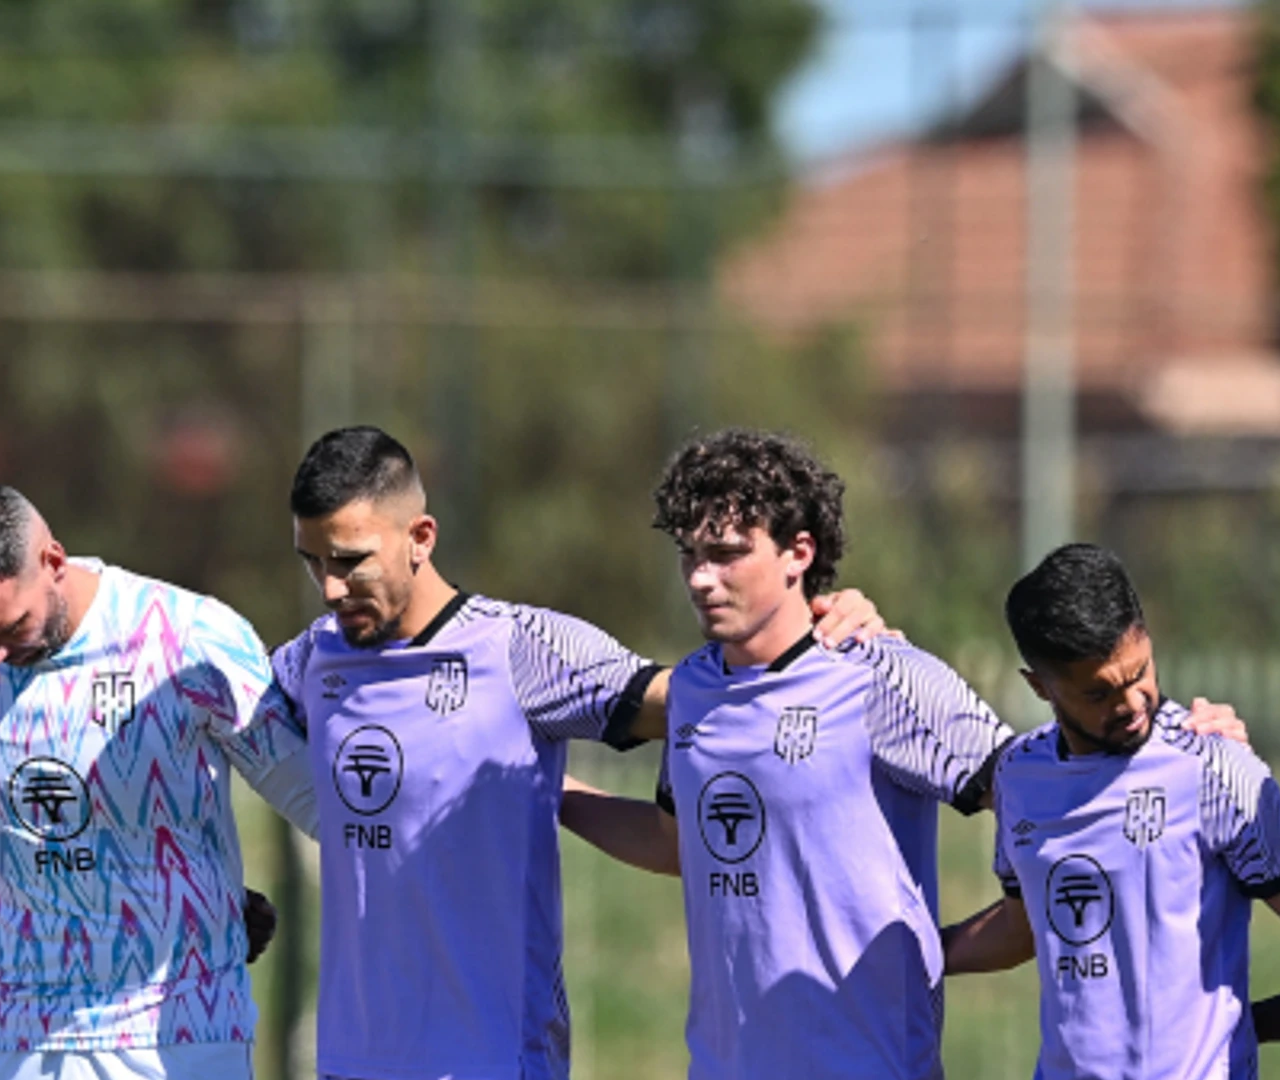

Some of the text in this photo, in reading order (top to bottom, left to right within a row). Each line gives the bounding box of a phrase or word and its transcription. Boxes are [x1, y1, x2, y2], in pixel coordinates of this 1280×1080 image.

[343, 824, 392, 849] FNB
[34, 847, 97, 875] FNB
[709, 872, 759, 896] FNB
[1056, 953, 1108, 979] FNB
